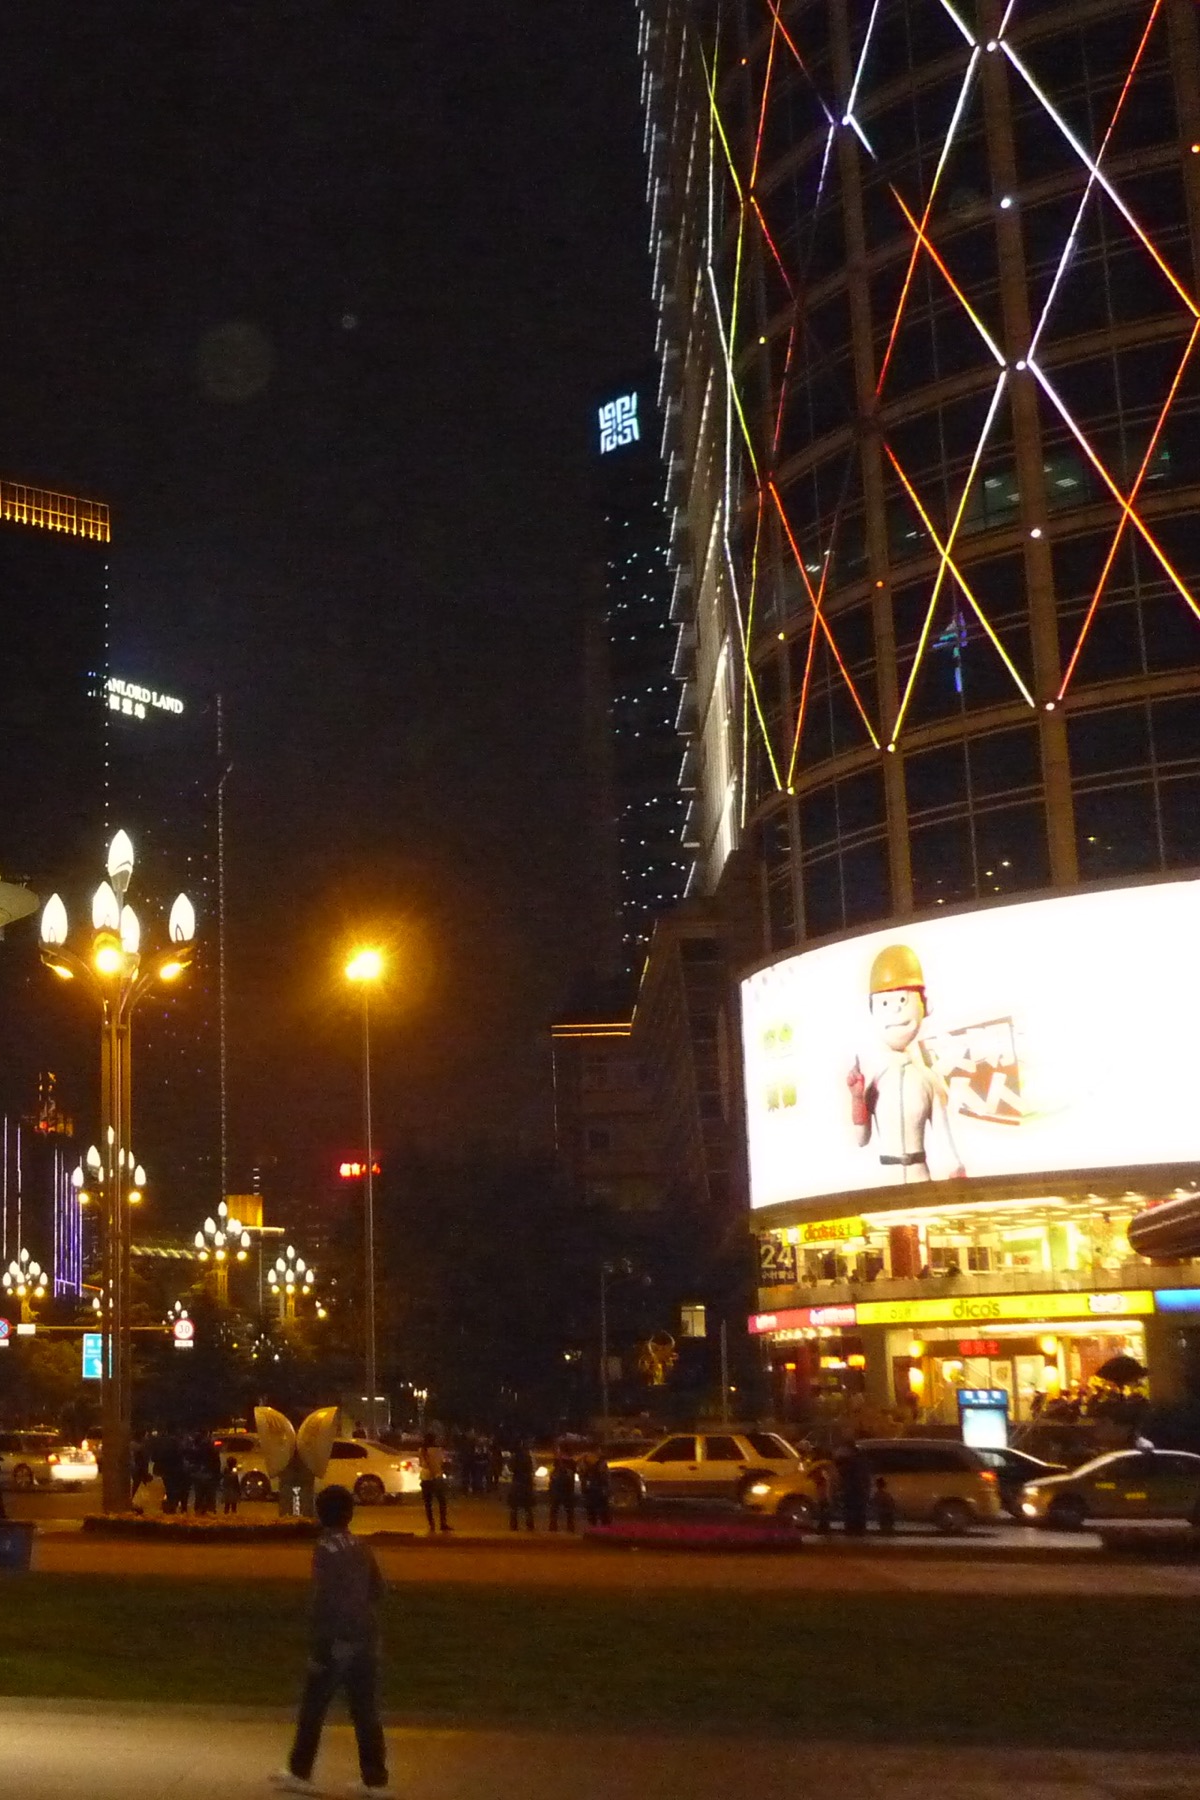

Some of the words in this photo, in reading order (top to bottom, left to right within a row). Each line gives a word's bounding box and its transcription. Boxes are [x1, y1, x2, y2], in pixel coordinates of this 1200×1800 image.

[151, 691, 184, 715] LAND
[760, 1244, 794, 1268] 24
[953, 1299, 1001, 1319] dico's
